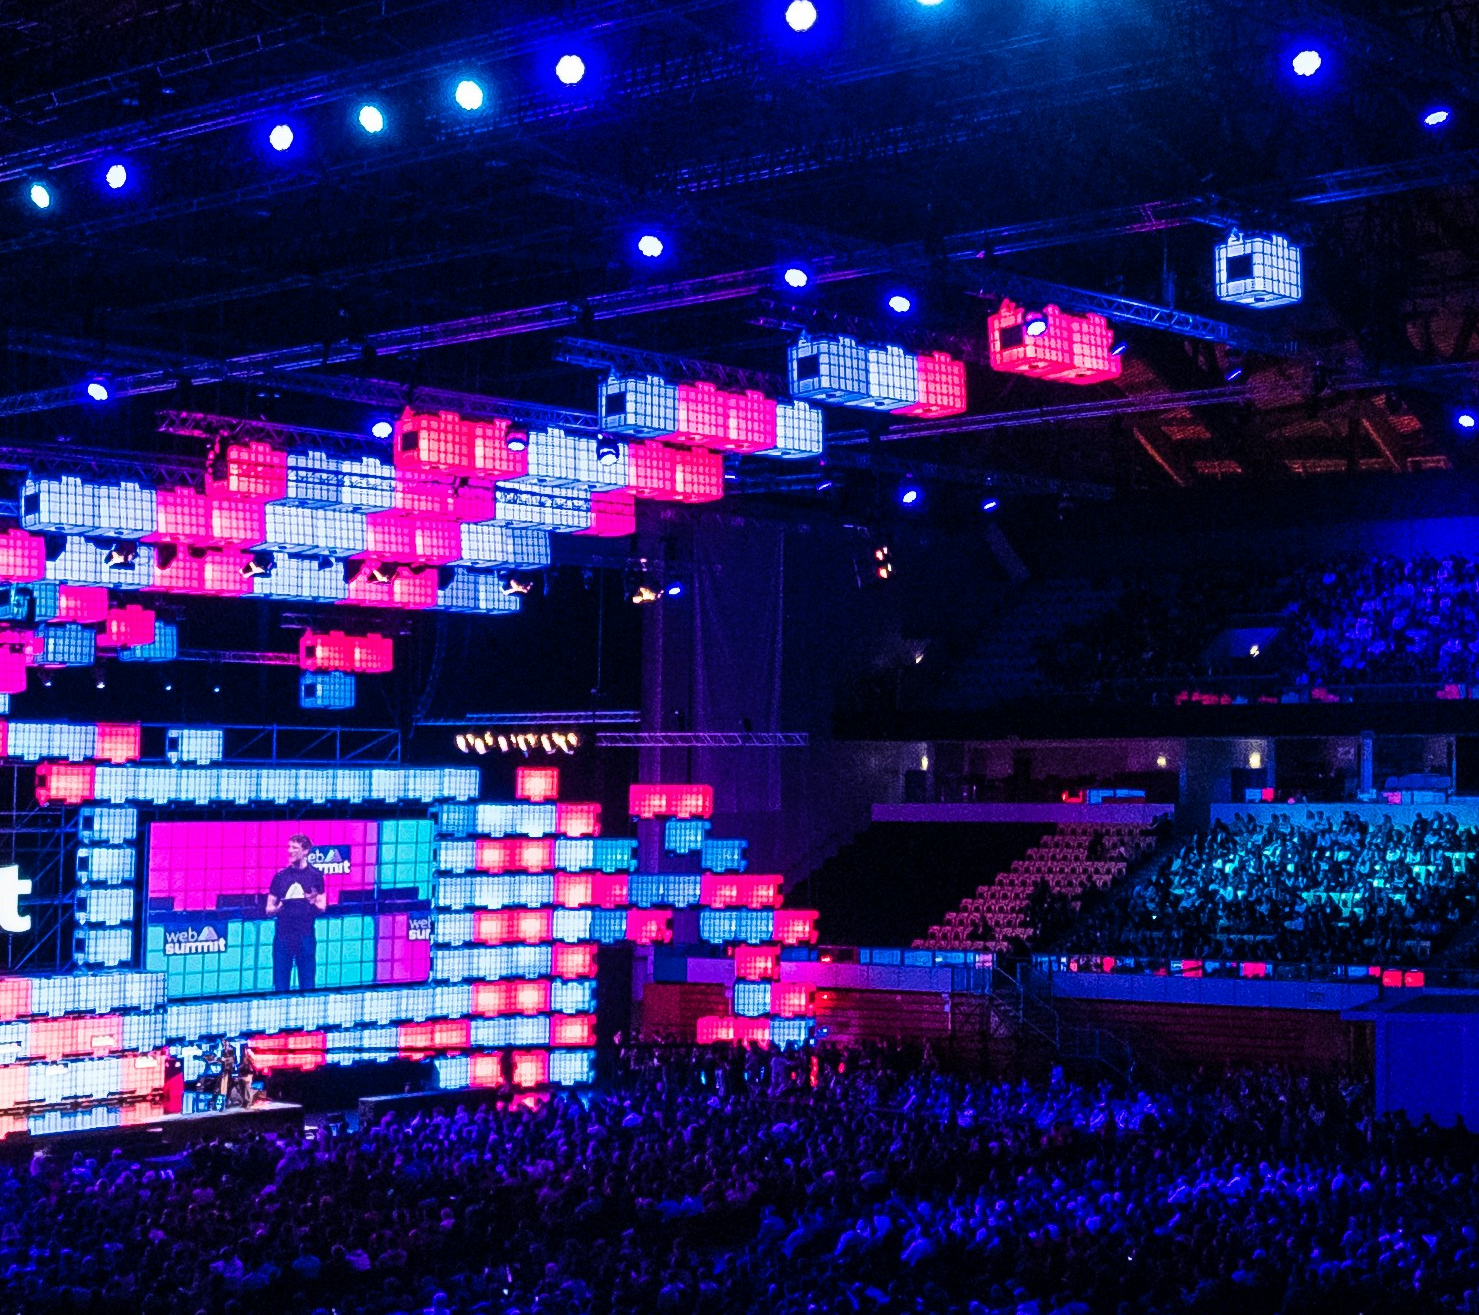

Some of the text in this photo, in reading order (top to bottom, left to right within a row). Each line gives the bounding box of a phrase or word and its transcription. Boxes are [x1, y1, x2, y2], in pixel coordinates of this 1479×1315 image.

[307, 848, 325, 864] eb
[165, 926, 198, 943] web
[165, 937, 226, 955] summit
